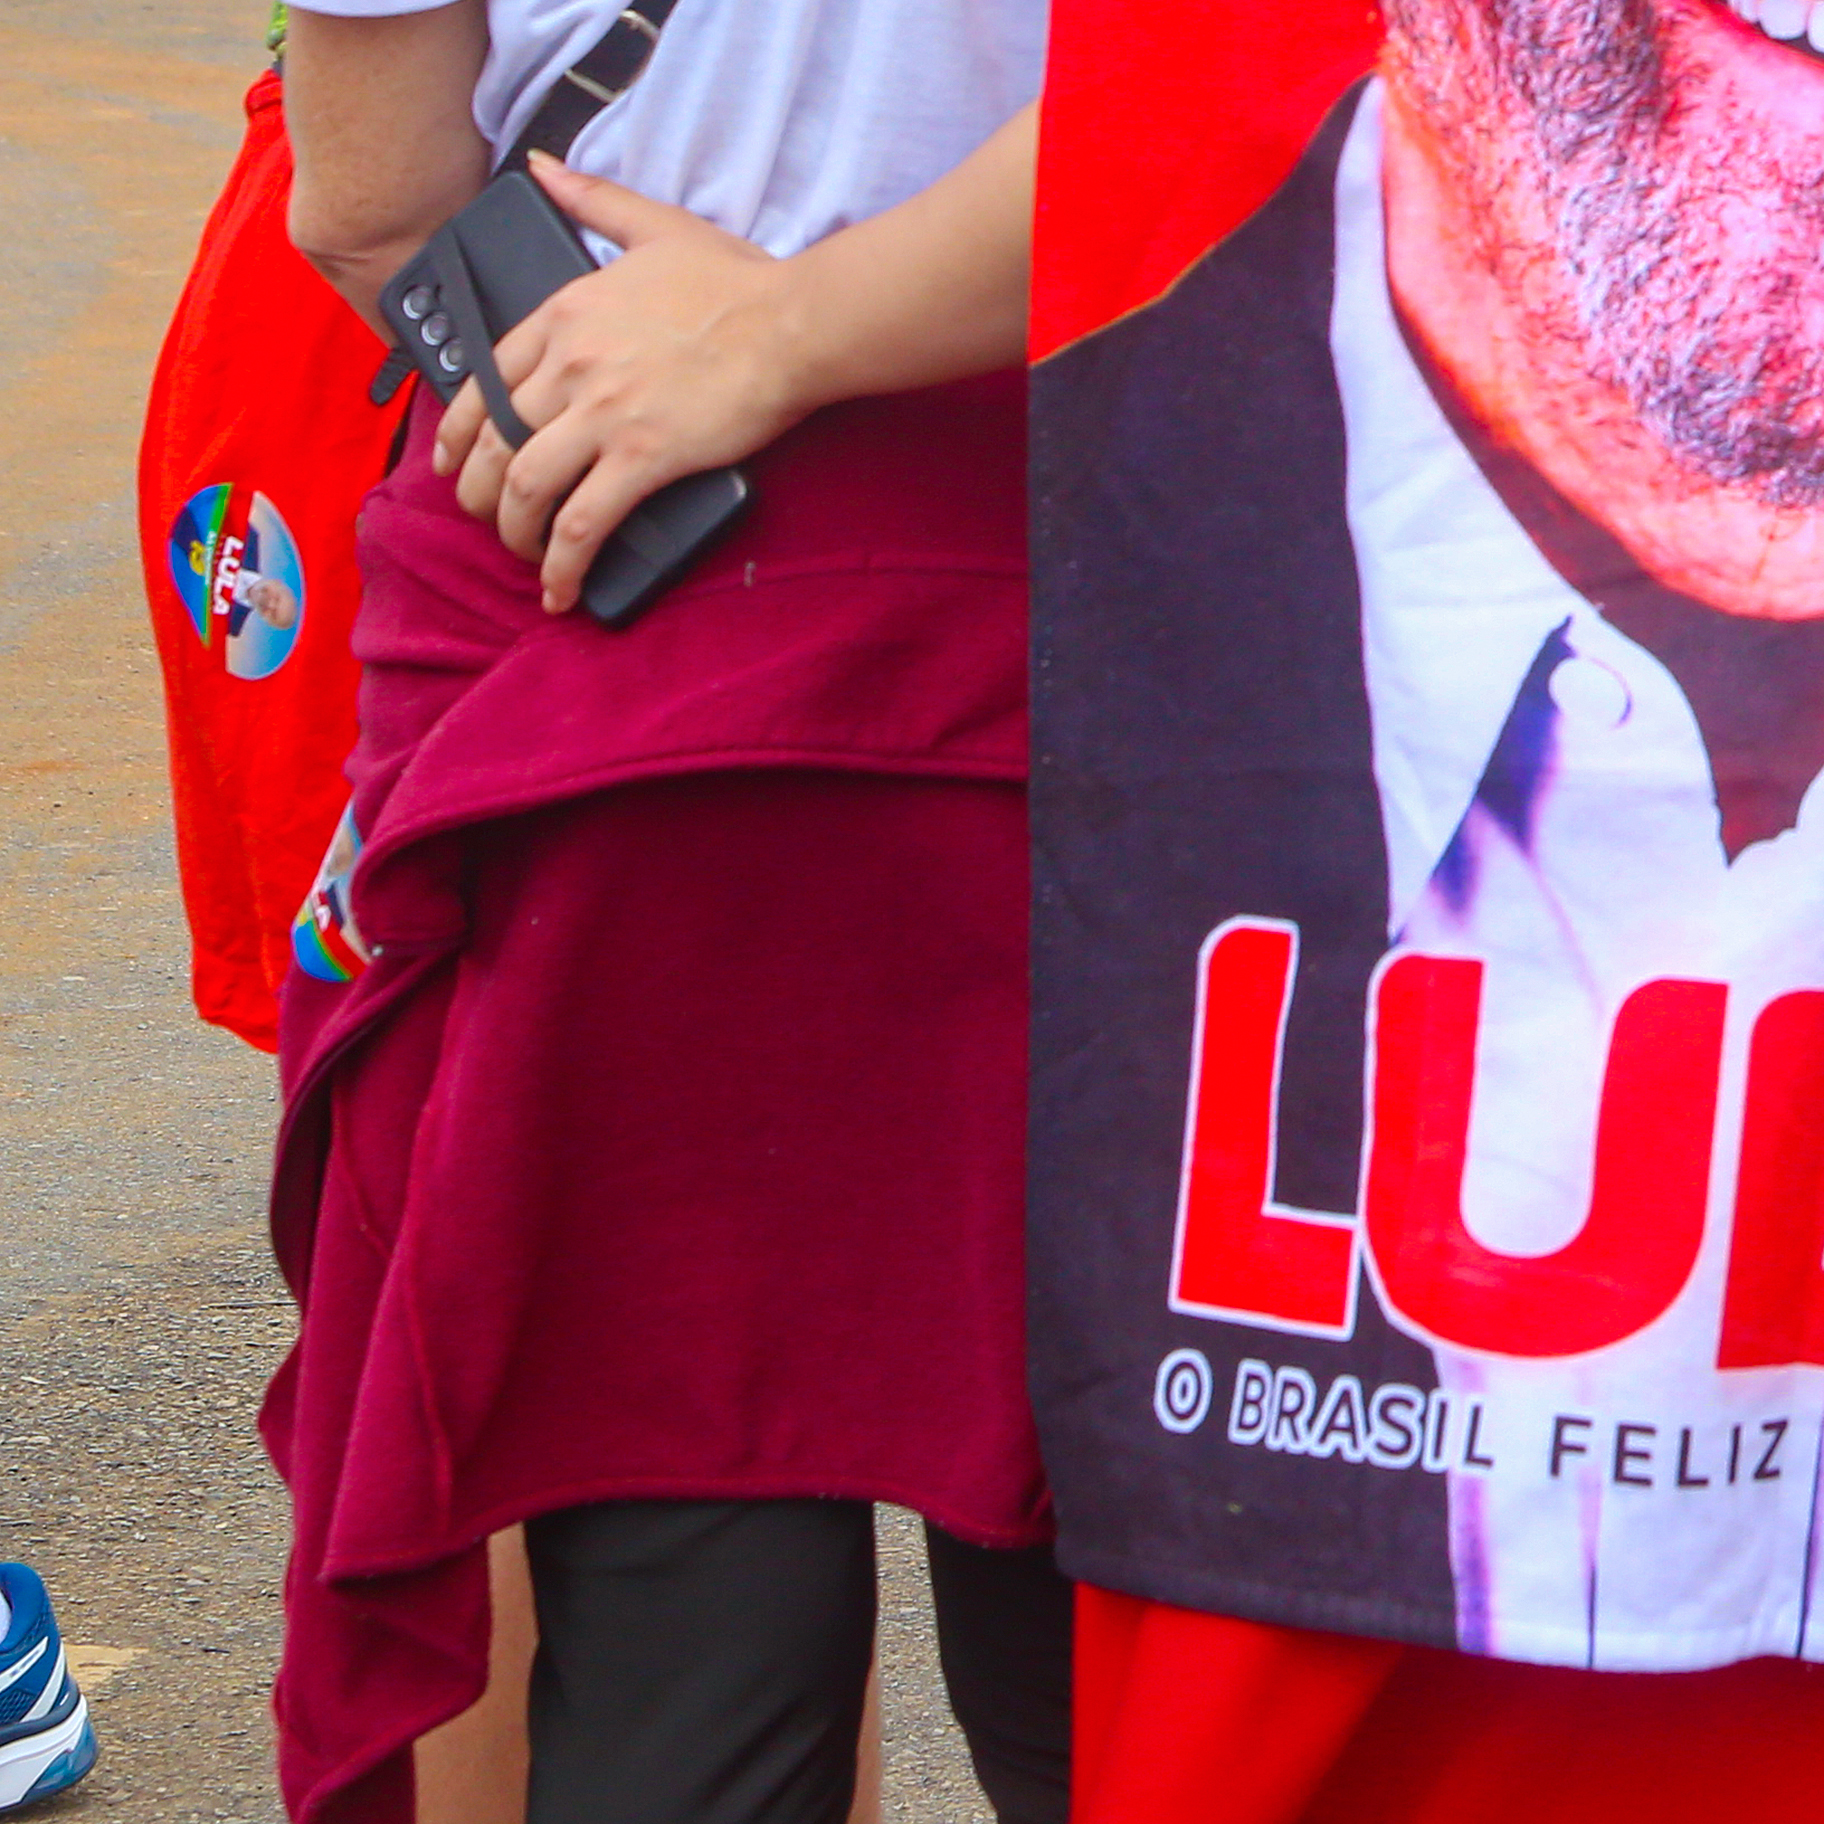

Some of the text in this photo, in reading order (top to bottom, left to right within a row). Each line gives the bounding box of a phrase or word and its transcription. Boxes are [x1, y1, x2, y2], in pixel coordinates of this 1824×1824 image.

[212, 535, 244, 616] LULA
[1155, 1349, 1213, 1432] O
[1230, 1362, 1496, 1474] BRASIL
[1549, 1416, 1789, 1489] FELIZ
